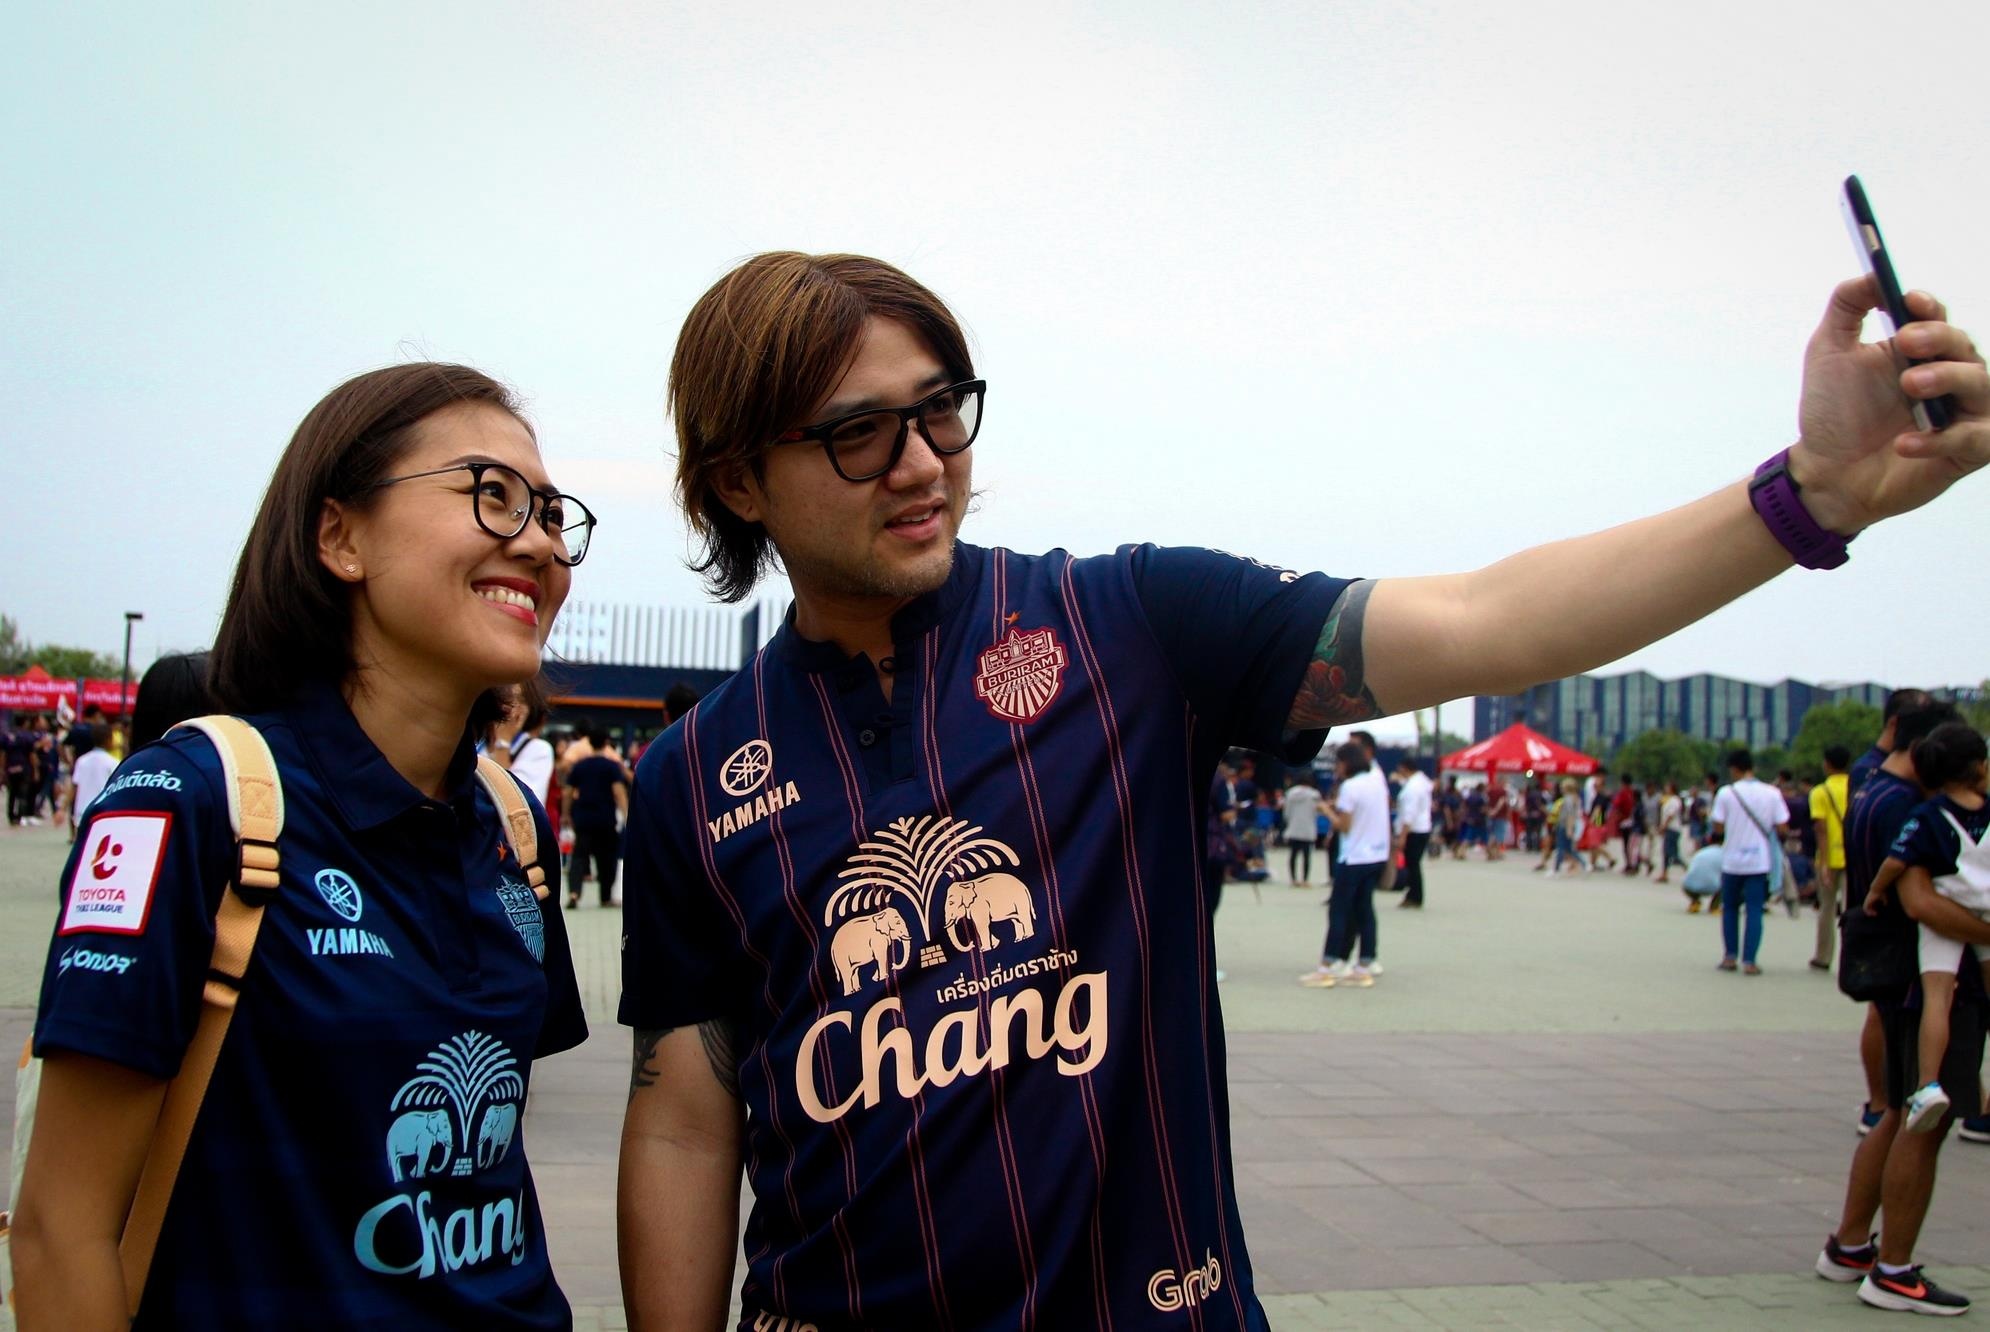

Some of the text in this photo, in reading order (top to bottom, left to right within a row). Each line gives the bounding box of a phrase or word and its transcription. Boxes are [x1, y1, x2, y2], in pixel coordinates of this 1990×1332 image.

[988, 655, 1054, 688] BURIRAM
[708, 780, 801, 843] YAMAHA
[79, 888, 126, 902] TOYOTA
[90, 903, 124, 914] LEAGUE
[306, 928, 394, 959] YAMAHA
[936, 949, 1078, 1004] เครื่องดื่มตราช้าง
[795, 970, 1108, 1123] Chang
[1147, 1246, 1221, 1312] Grab
